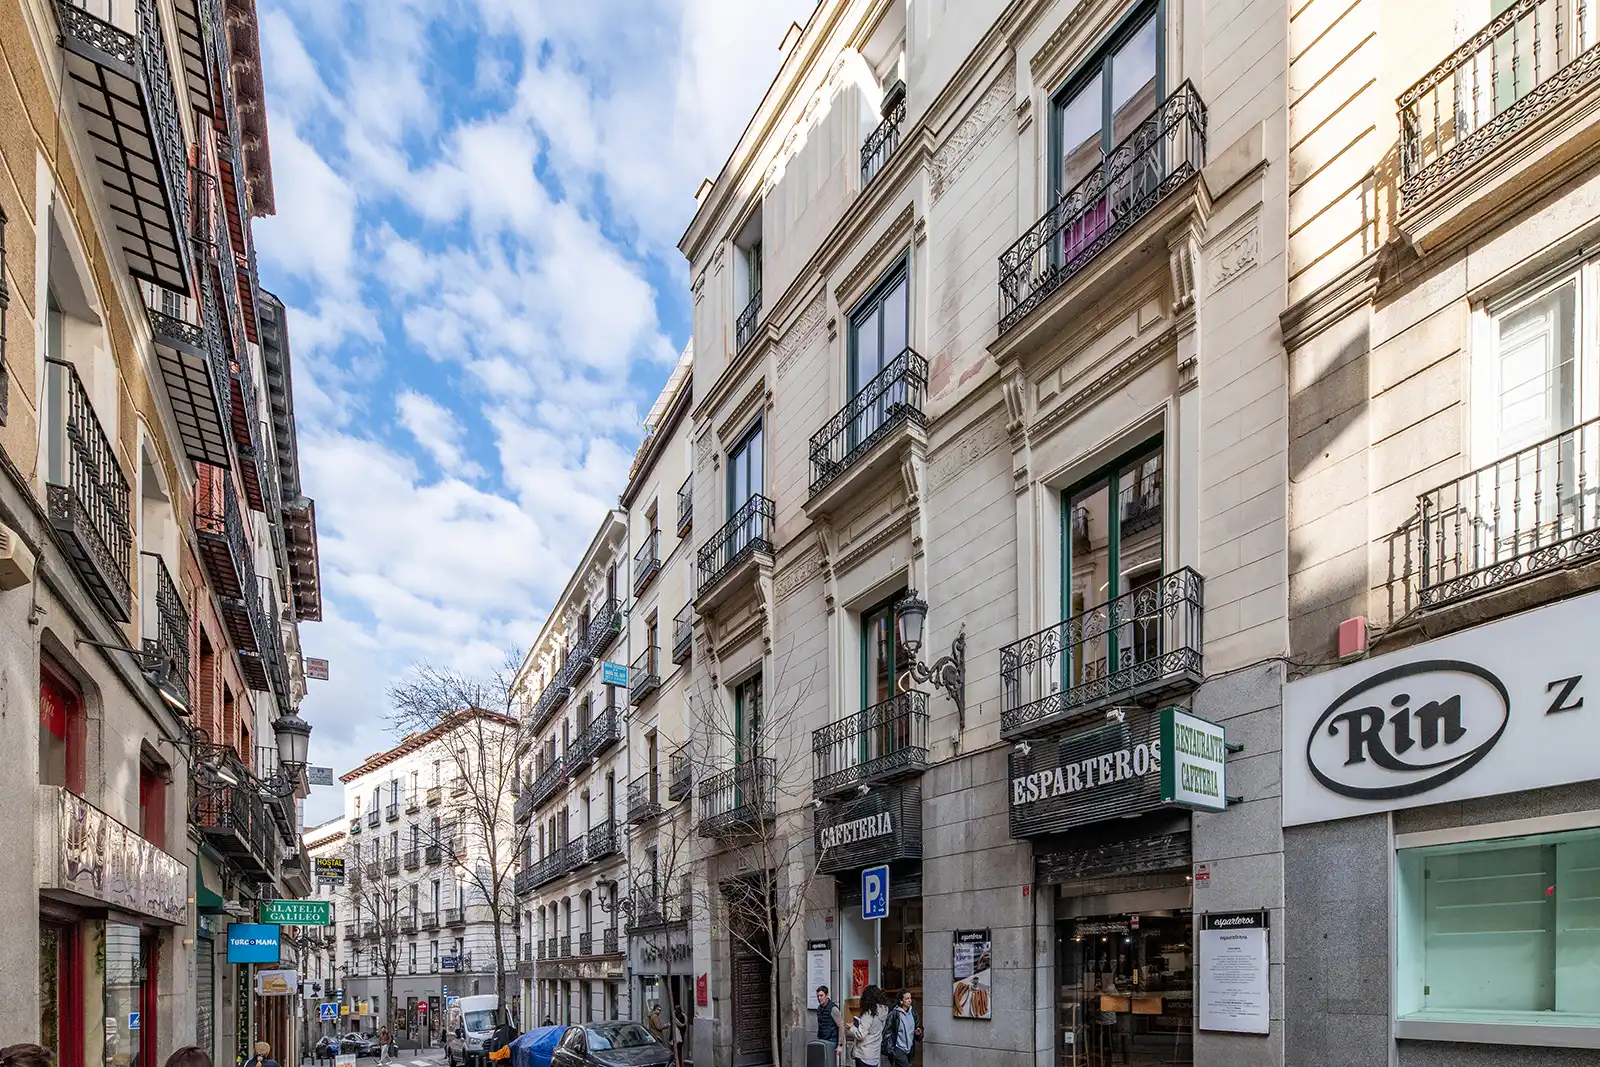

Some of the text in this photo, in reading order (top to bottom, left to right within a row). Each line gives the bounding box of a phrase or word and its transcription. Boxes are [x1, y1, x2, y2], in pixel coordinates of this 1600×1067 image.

[1176, 722, 1222, 764] RESTAURANTE
[1328, 693, 1468, 770] Rin
[1013, 740, 1160, 806] ESPARTEROS
[1181, 762, 1219, 798] CAFETERIA
[821, 812, 893, 849] CAFETERIA
[317, 858, 343, 867] HOSTAL
[866, 874, 880, 914] P
[270, 912, 320, 921] GALILEO
[1214, 916, 1254, 927] esparteros
